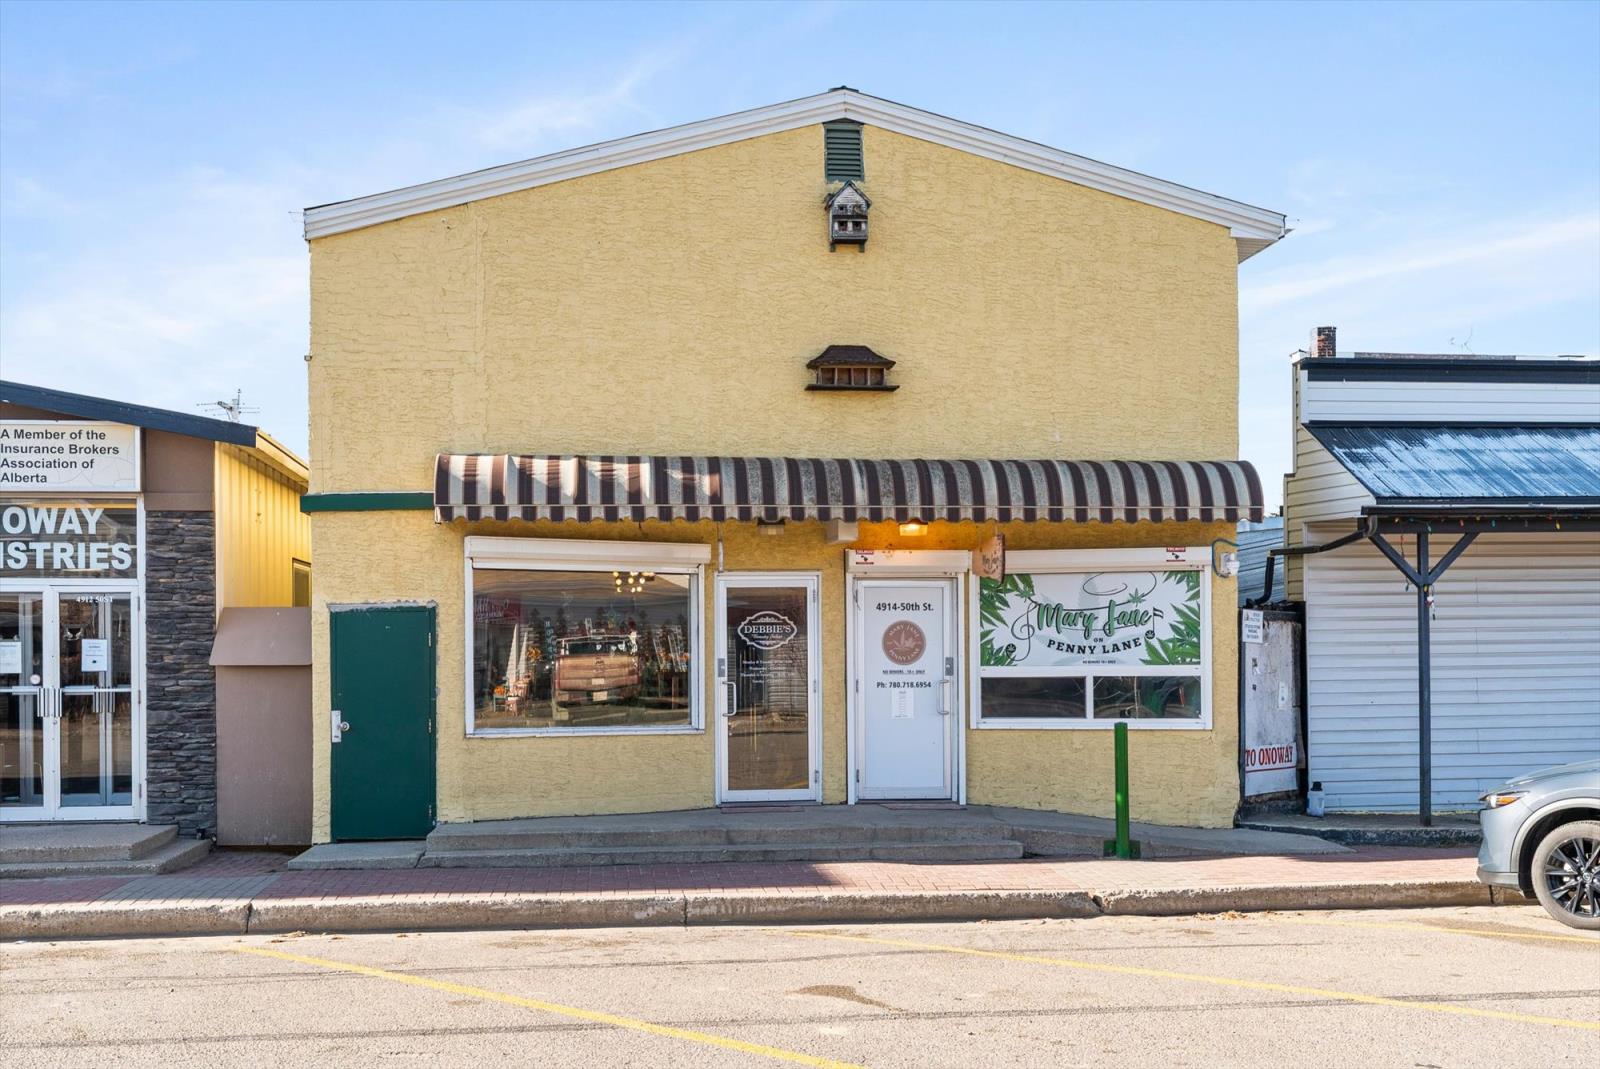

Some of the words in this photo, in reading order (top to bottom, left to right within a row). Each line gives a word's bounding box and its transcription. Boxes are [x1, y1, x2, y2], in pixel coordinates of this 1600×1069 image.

[0, 429, 10, 440] A
[14, 429, 66, 440] Member
[69, 430, 83, 440] of
[86, 430, 106, 440] the
[0, 443, 65, 454] Insurance
[69, 444, 120, 455] Brokers
[0, 458, 78, 469] Association
[81, 458, 95, 469] of
[0, 472, 48, 483] Alberta
[2, 506, 105, 535] OWAY
[76, 595, 93, 603] 4912
[876, 602, 920, 611] 4914-50th
[922, 602, 934, 611] St.
[1037, 602, 1099, 640] Mary
[744, 625, 792, 634] DEBBIE'S
[1047, 639, 1097, 655] PENNY
[1102, 637, 1142, 654] LANE
[876, 681, 888, 689] Ph:
[1258, 745, 1294, 766] ONOWAY
